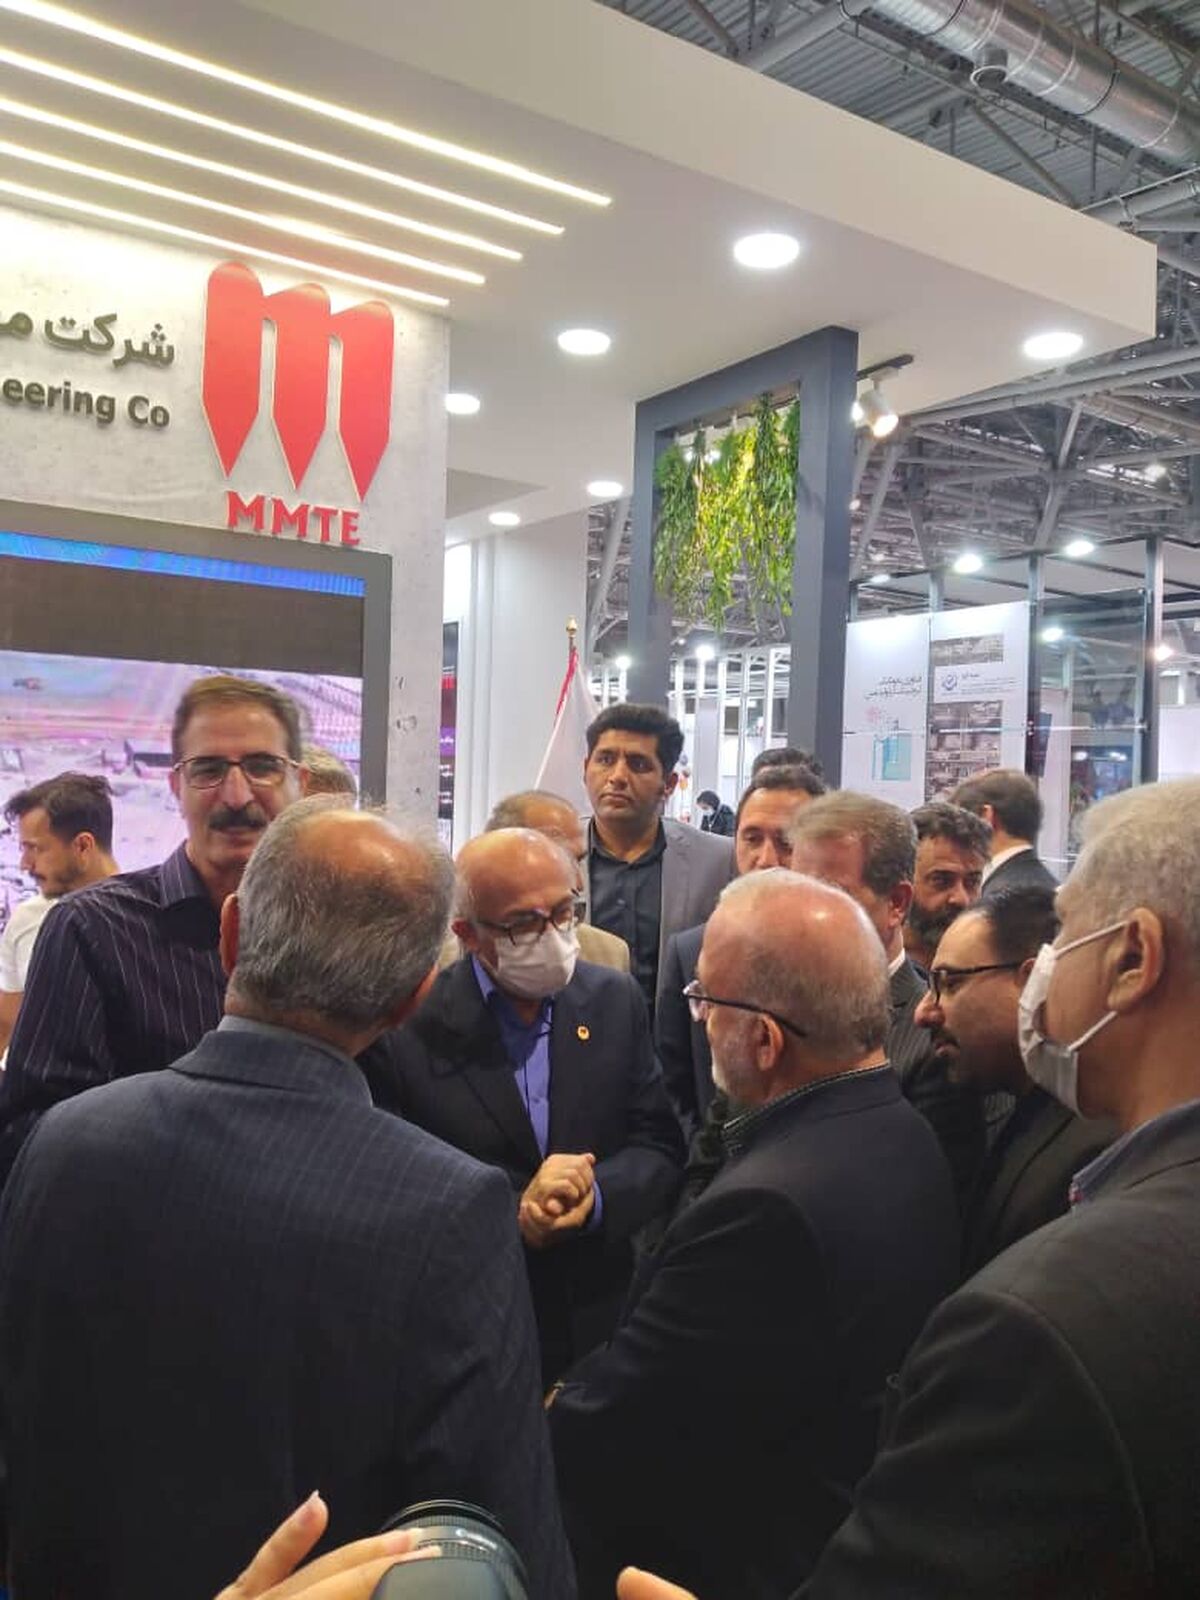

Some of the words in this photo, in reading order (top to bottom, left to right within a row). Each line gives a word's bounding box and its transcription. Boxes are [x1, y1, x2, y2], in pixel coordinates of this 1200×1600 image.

[45, 313, 175, 368] شرکت
[127, 395, 171, 428] Co
[227, 490, 361, 546] MMTE
